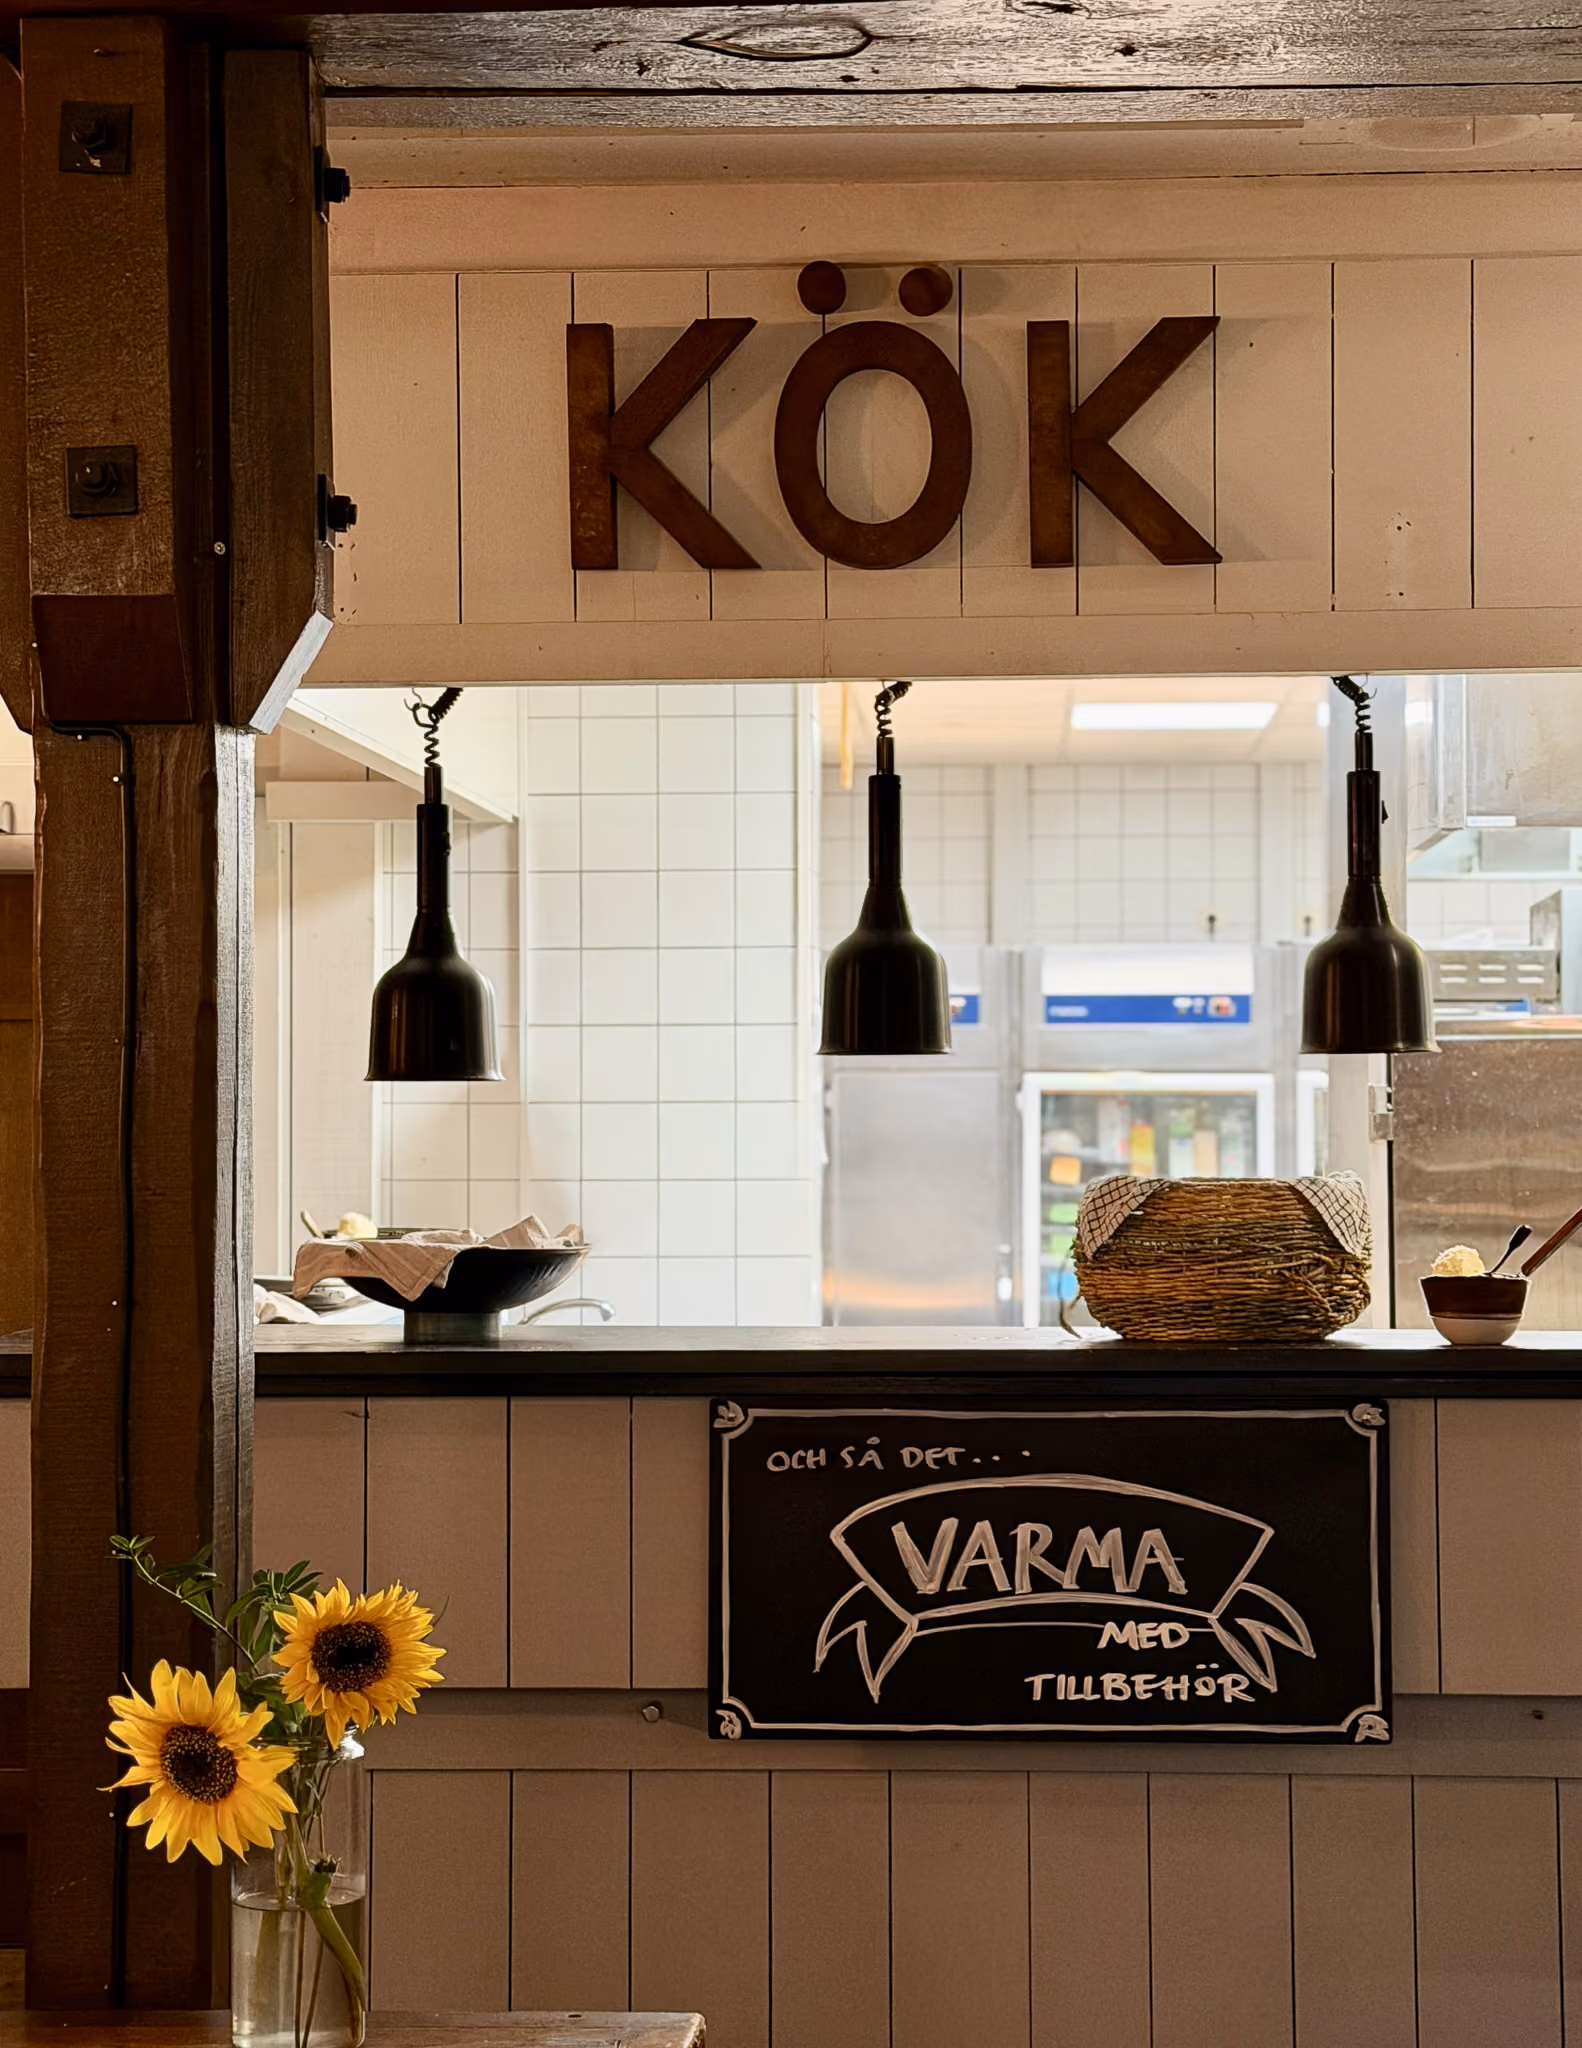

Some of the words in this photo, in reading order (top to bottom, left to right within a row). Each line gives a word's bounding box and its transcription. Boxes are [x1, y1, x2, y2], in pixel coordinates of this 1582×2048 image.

[566, 260, 1223, 570] KÖK
[766, 1448, 827, 1472] OCH
[840, 1436, 885, 1470] SÅ
[891, 1517, 1189, 1595] VARMA
[1097, 1620, 1190, 1651] MED
[1024, 1662, 1256, 1703] TILLBEHÖR
